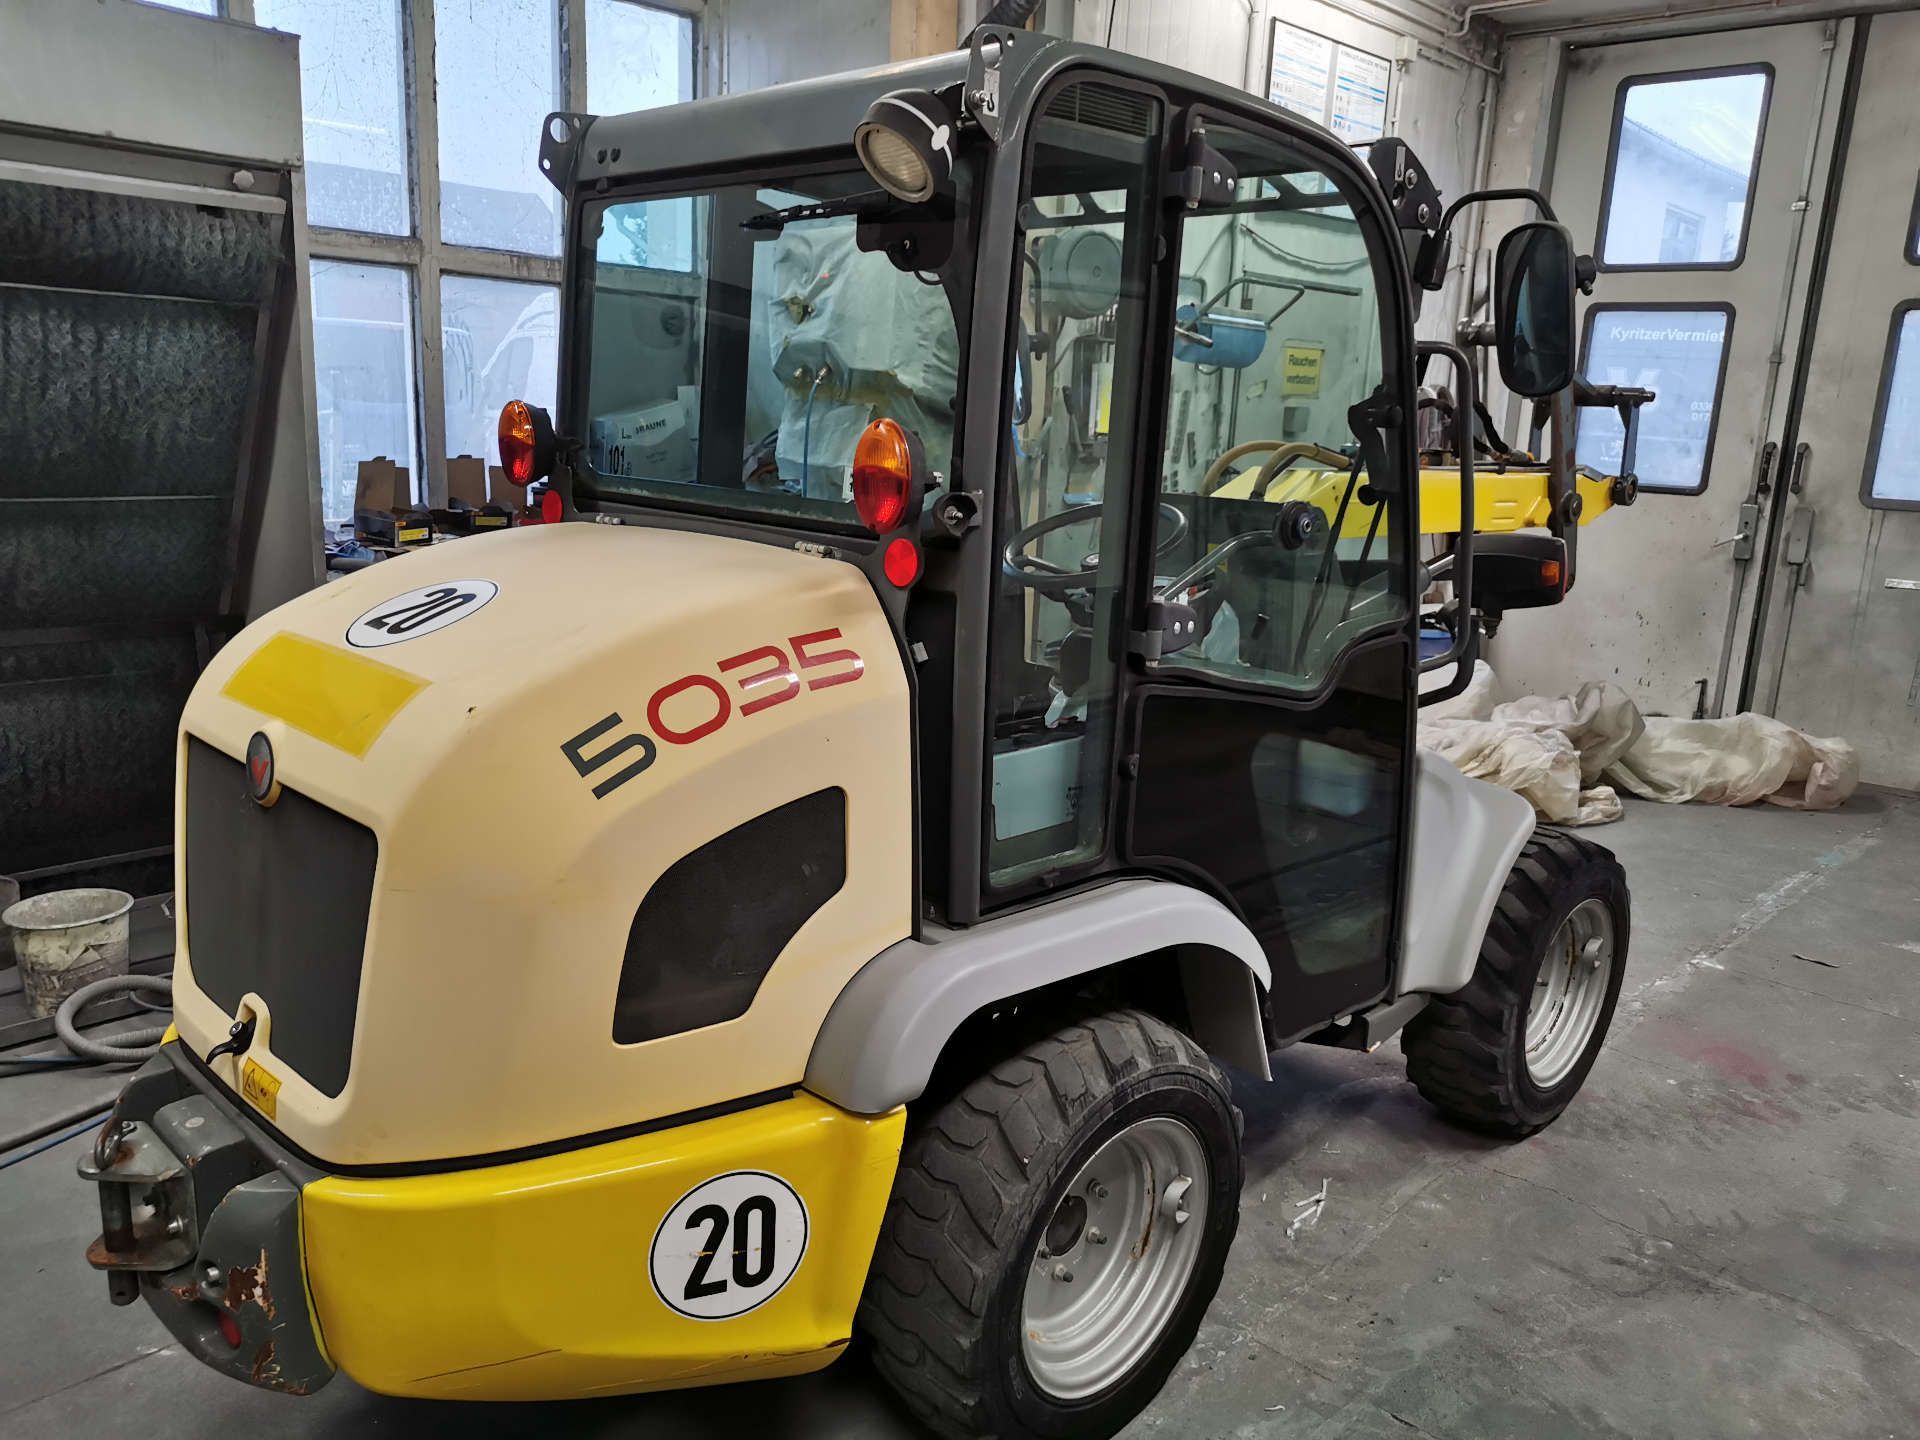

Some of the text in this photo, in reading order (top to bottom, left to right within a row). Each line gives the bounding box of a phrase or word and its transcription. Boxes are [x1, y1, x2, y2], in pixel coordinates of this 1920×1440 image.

[608, 445, 625, 474] 101
[364, 588, 476, 633] 20
[561, 628, 864, 799] 5035
[684, 1195, 776, 1300] 20
